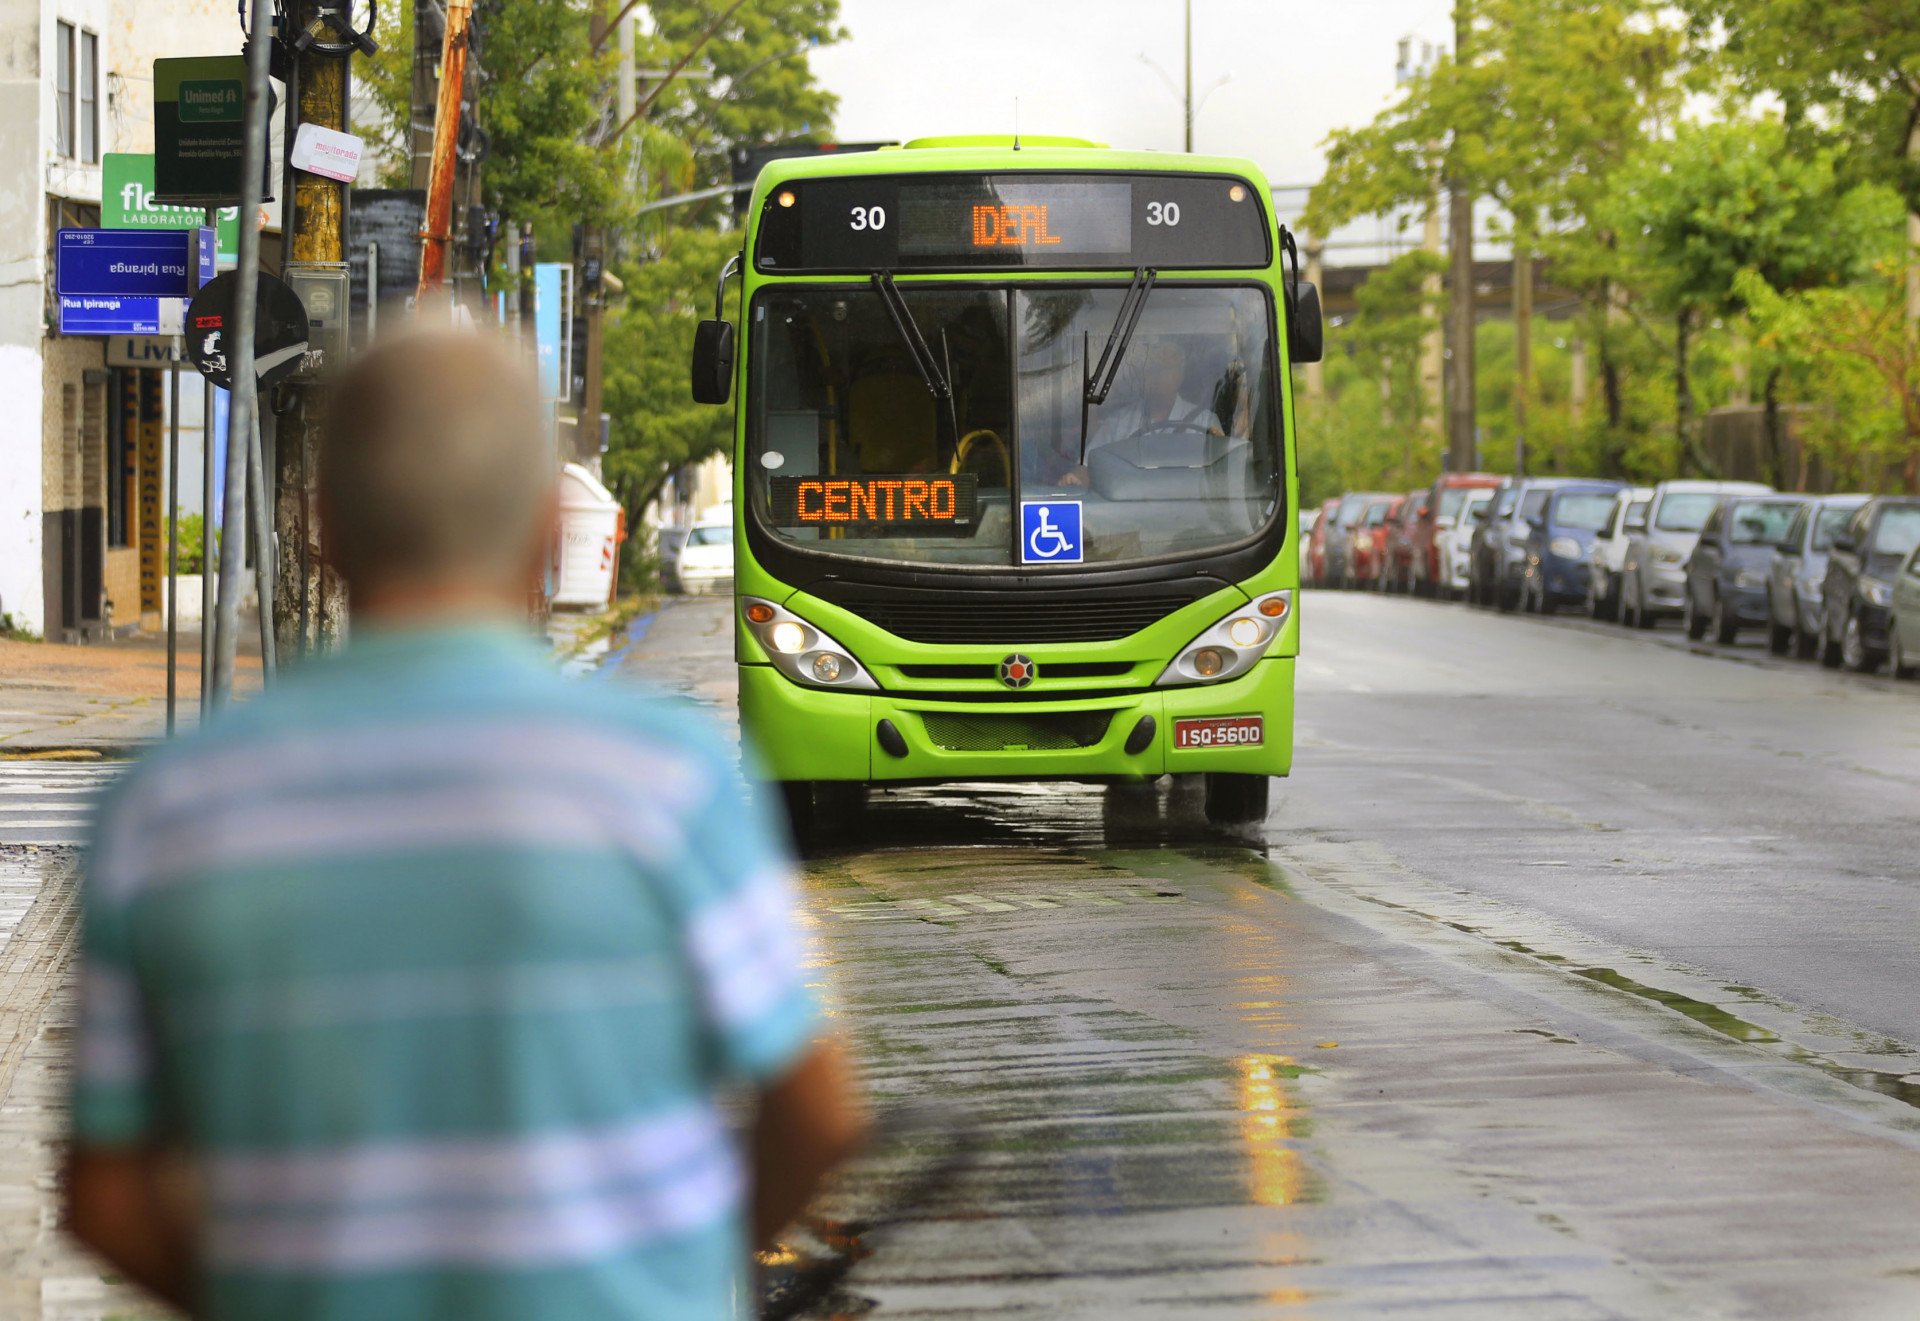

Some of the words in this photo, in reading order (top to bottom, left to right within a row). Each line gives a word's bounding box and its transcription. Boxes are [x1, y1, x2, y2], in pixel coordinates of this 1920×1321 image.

[185, 89, 224, 103] Unimed
[850, 206, 885, 230] 30
[1146, 202, 1181, 226] 30
[973, 204, 1061, 246] IDEAL
[109, 262, 159, 276] Ipiranga
[162, 265, 185, 276] Rua
[63, 299, 82, 309] Rua
[84, 299, 121, 311] Ipiranga
[798, 480, 955, 520] CENTRO
